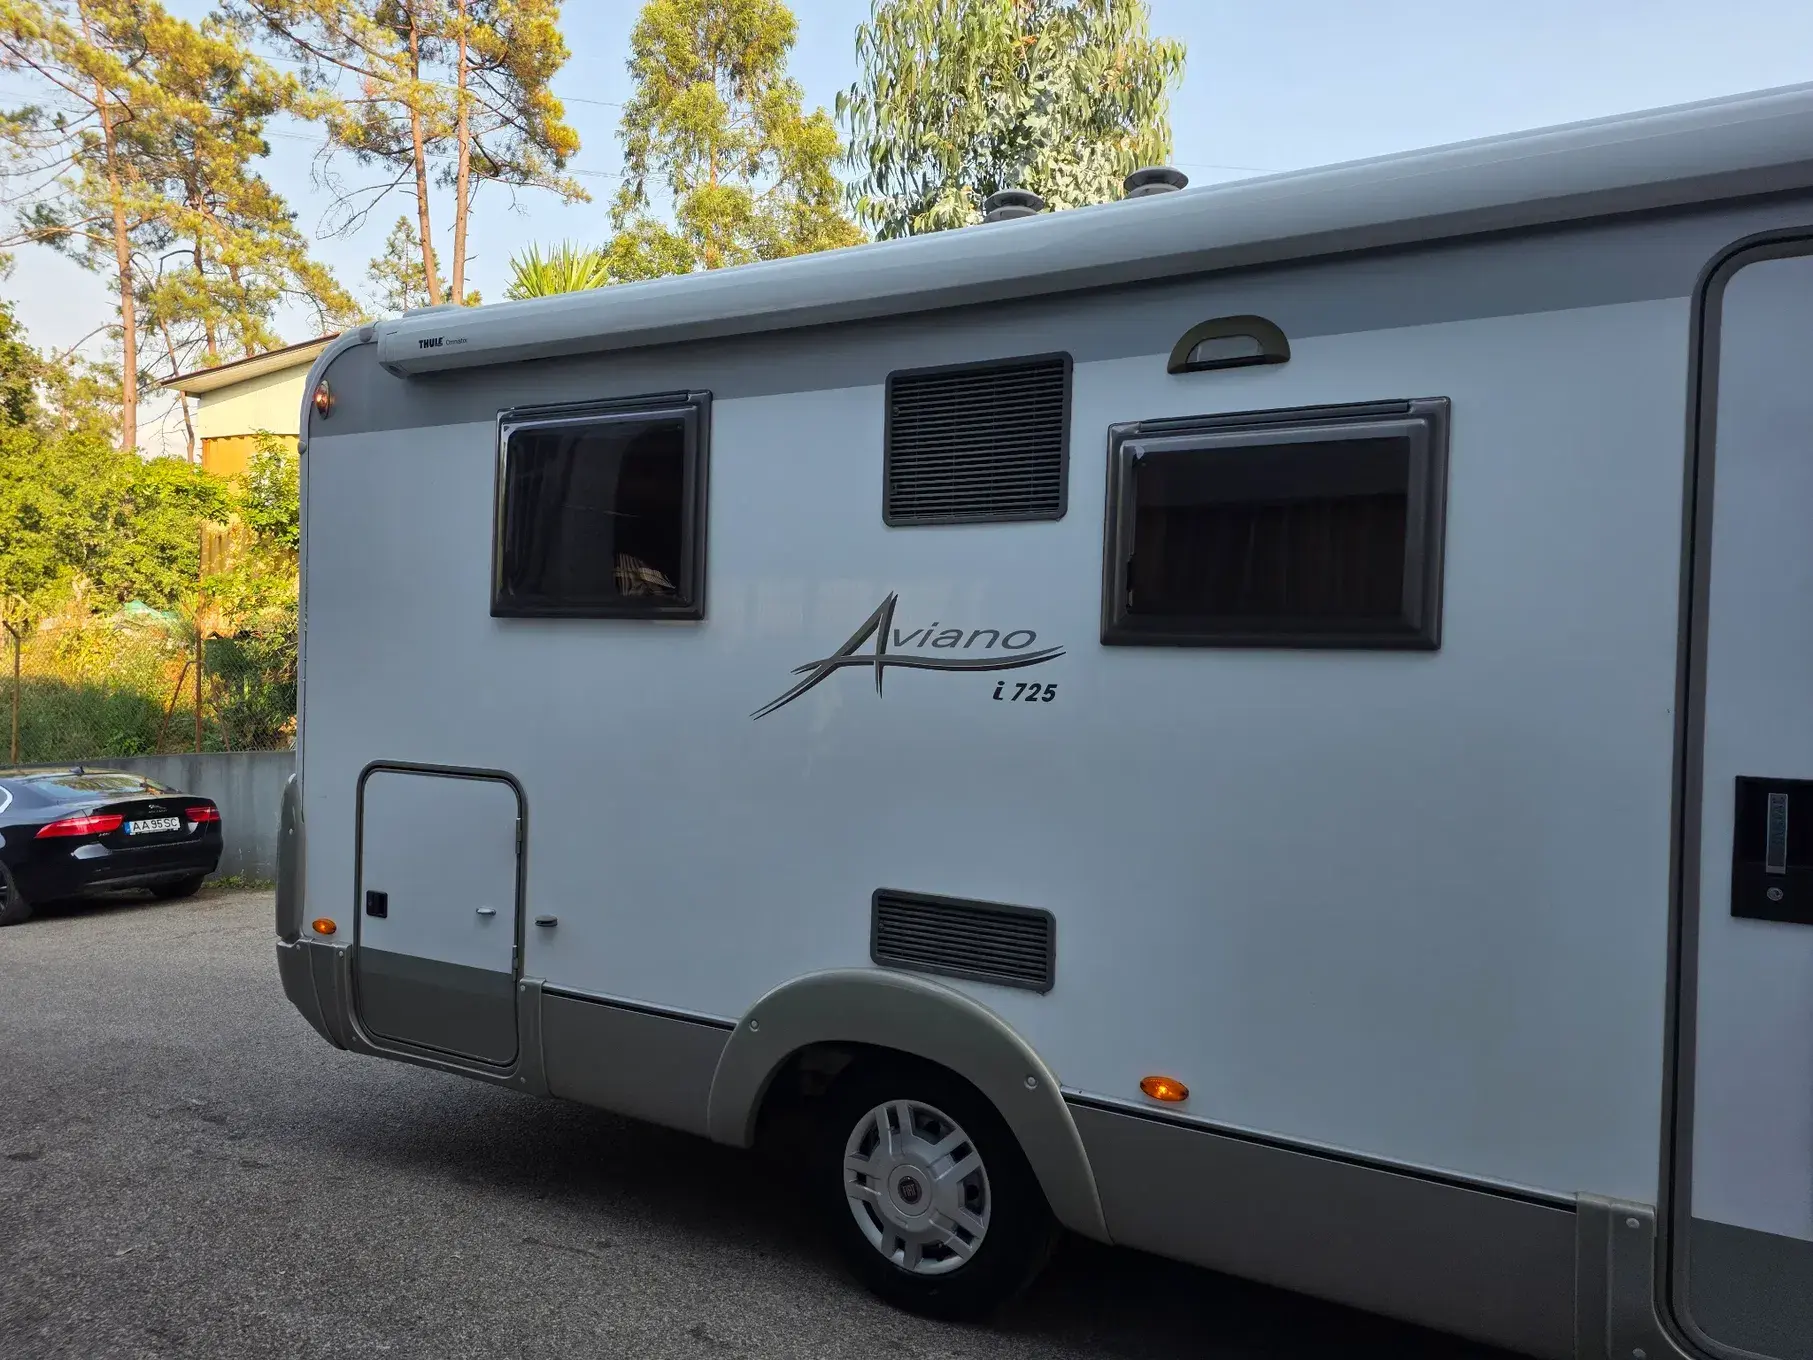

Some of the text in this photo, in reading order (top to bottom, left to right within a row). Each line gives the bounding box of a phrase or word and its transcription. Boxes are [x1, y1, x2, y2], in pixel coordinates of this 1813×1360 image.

[419, 337, 444, 349] THULE
[749, 590, 1066, 721] Aviano
[993, 681, 1058, 702] i 725
[902, 1183, 916, 1197] FIAT
